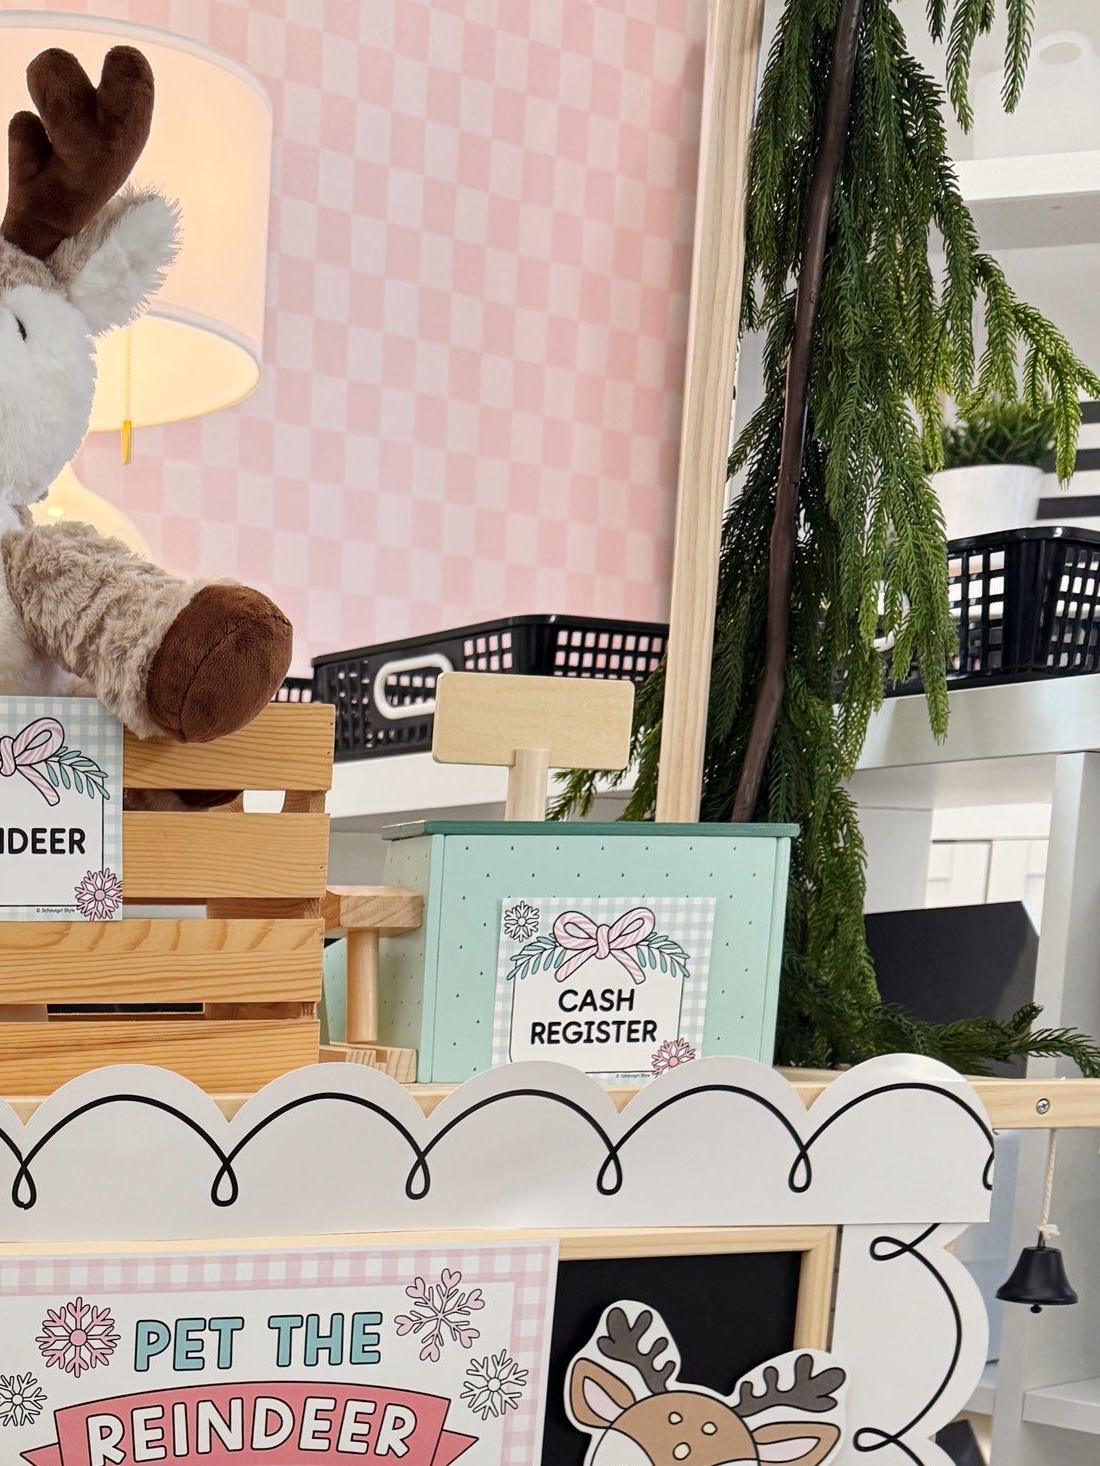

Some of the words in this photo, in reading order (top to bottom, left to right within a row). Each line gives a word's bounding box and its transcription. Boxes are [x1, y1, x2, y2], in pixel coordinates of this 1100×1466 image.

[558, 988, 635, 1012] CASH
[530, 1020, 658, 1045] REGISTER
[134, 1317, 244, 1372] PET
[268, 1311, 383, 1367] THE
